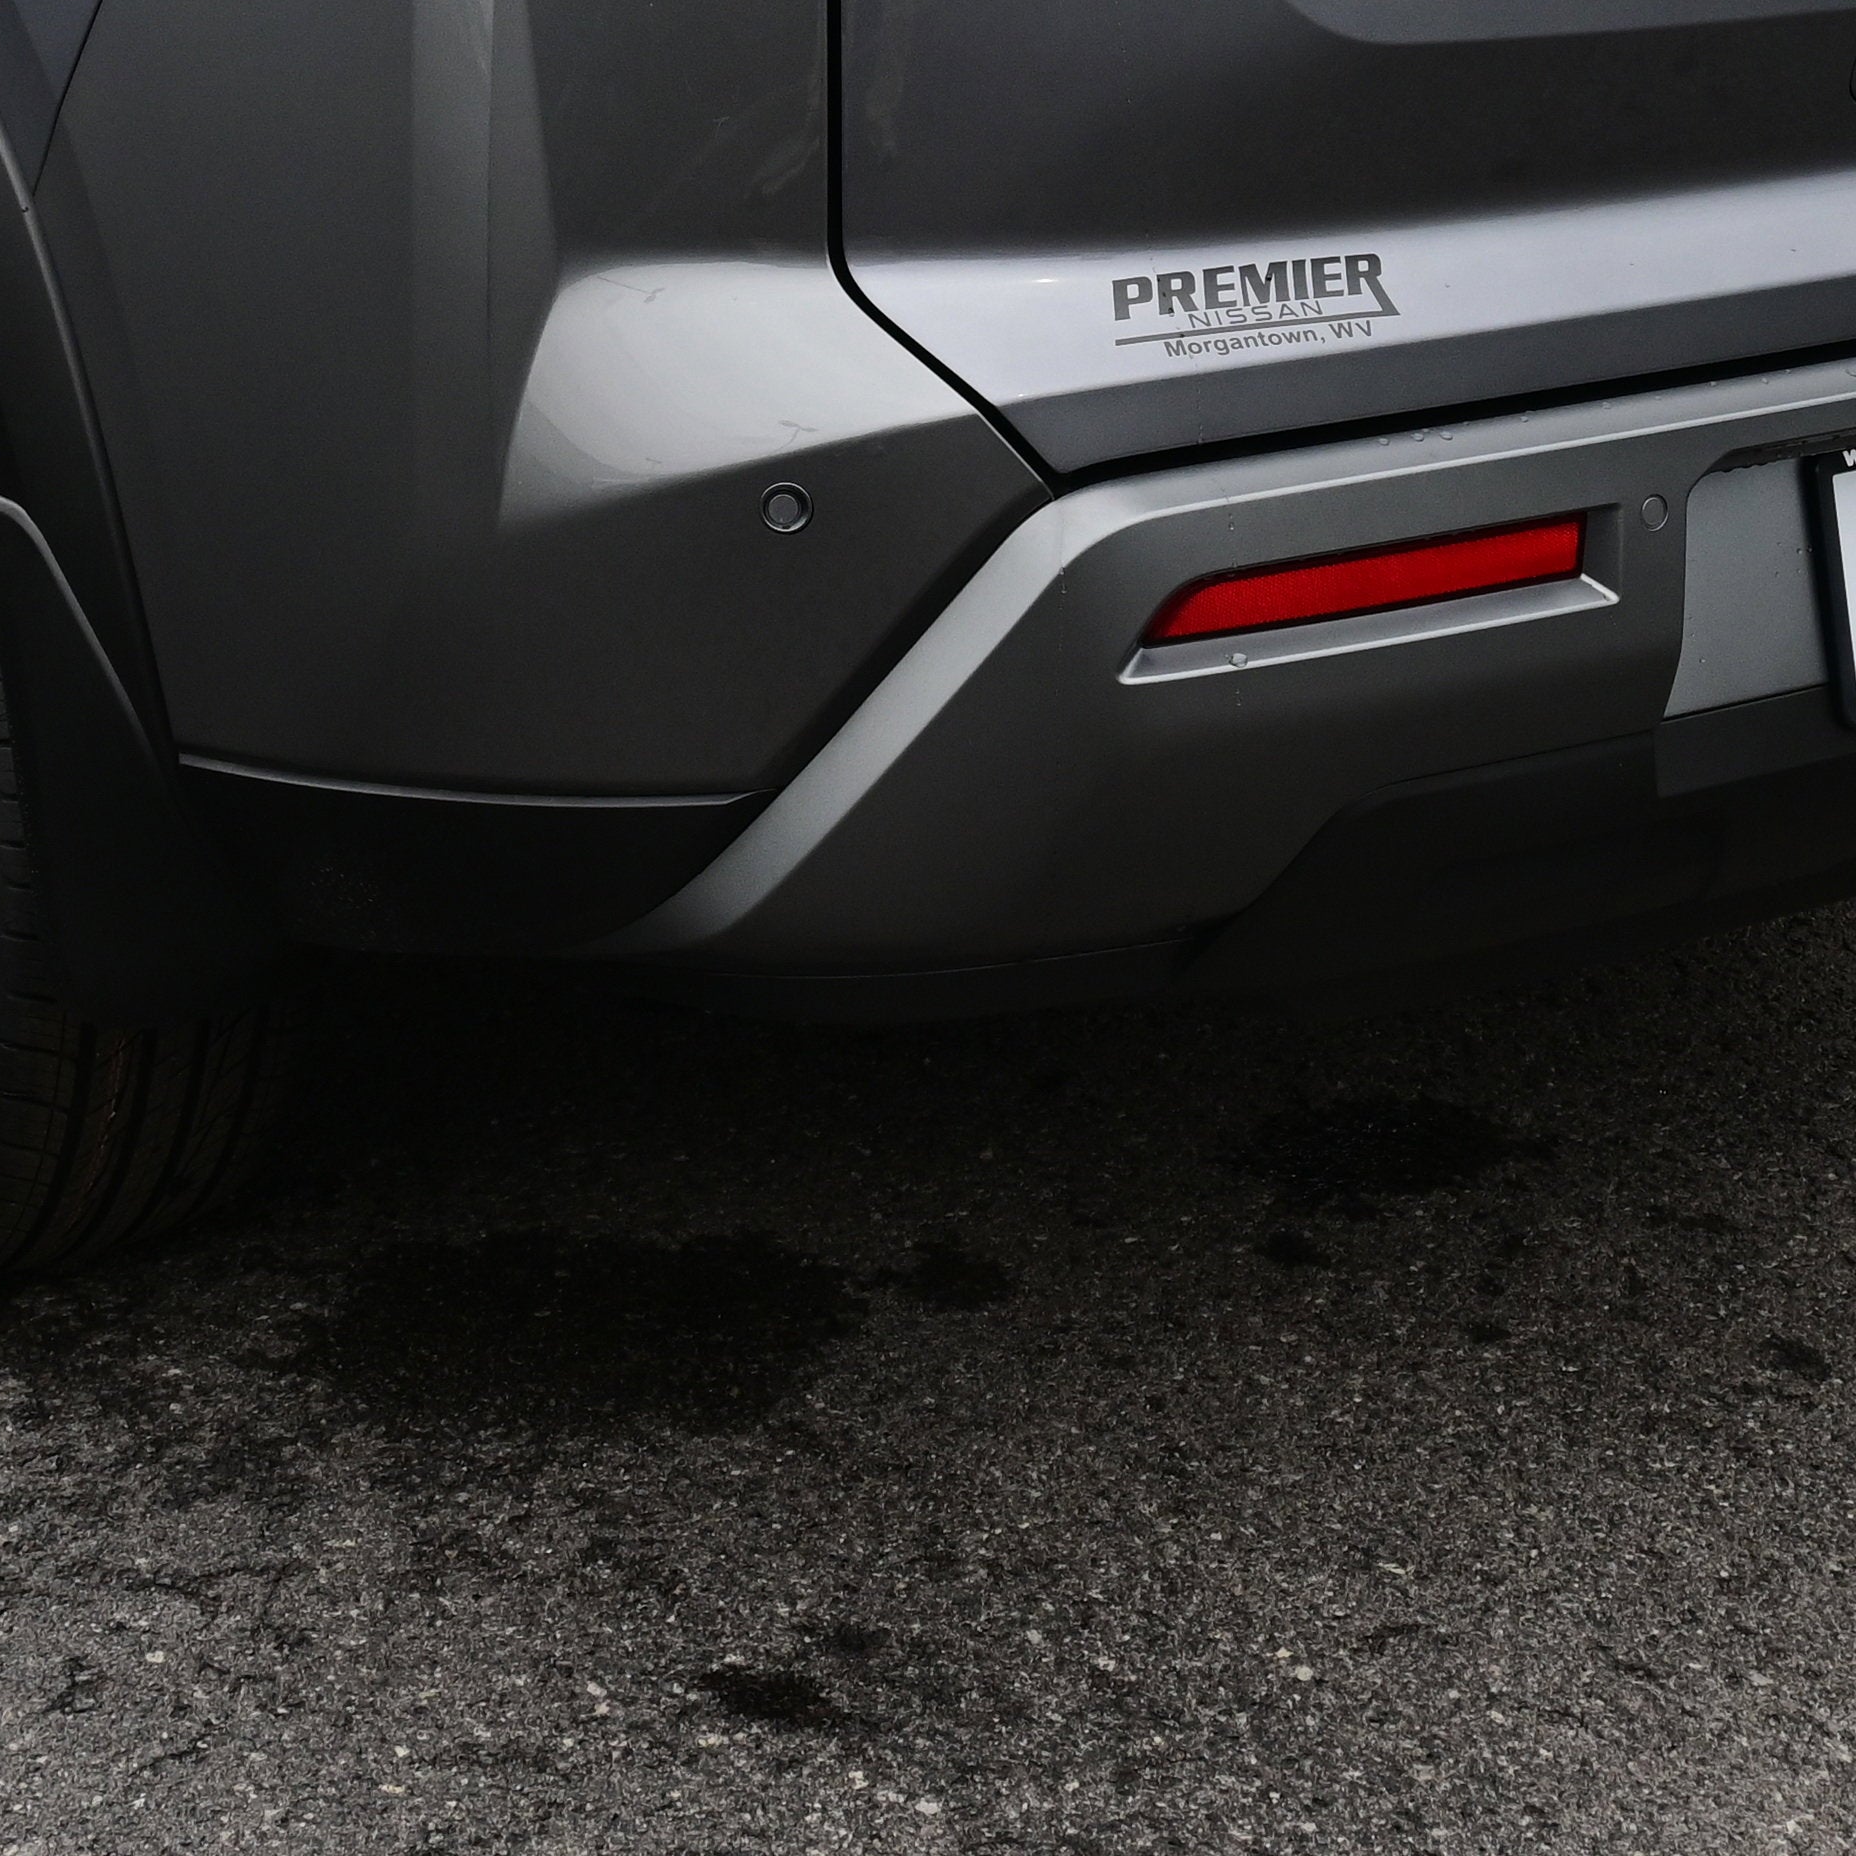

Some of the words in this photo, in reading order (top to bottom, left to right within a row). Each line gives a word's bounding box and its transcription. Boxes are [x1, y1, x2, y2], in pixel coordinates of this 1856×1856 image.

[1111, 252, 1401, 322] PREMIER
[1188, 299, 1324, 329] NISSAN
[1163, 326, 1327, 358] Morgantown,
[1328, 319, 1374, 339] WV
